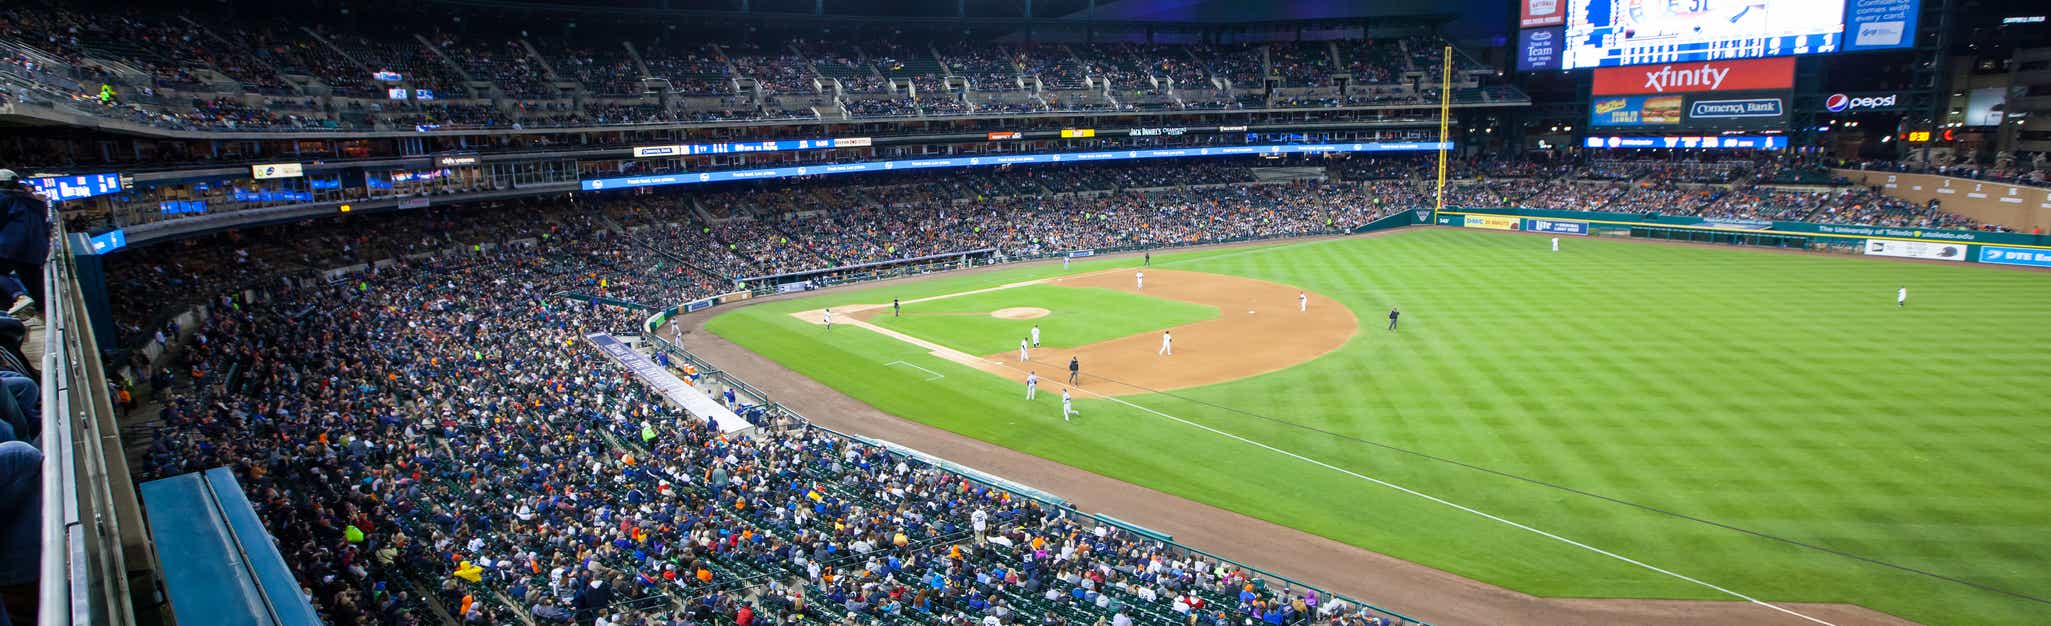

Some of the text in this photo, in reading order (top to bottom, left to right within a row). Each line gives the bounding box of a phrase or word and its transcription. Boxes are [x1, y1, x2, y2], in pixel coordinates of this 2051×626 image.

[1527, 47, 1552, 56] Team
[1644, 63, 1730, 92] xfinity
[1747, 101, 1775, 112] Bank
[1850, 94, 1897, 109] pepsi
[1819, 225, 1975, 240] The University of Toledo utoledo.edu
[2005, 251, 2033, 260] DTE
